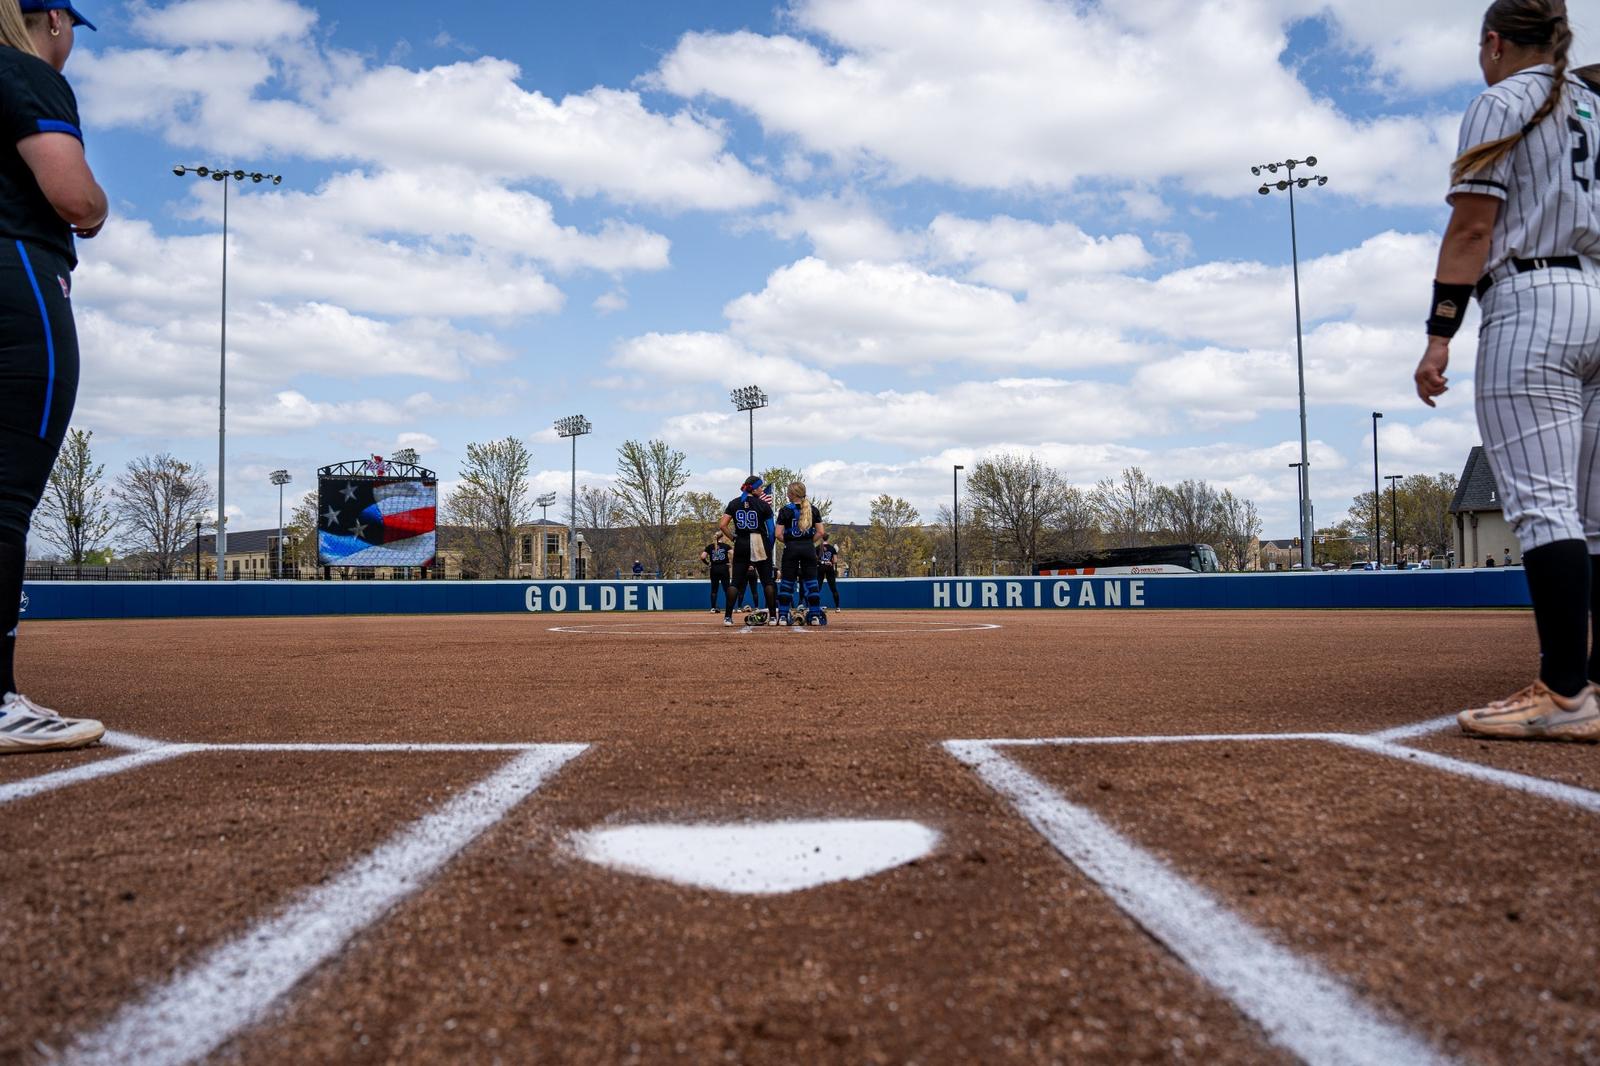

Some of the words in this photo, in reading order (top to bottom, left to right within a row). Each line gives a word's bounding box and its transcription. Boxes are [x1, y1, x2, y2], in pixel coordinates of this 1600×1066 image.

[1567, 114, 1600, 193] 2
[736, 509, 759, 530] 99
[525, 585, 664, 611] GOLDEN
[933, 580, 1145, 607] HURRICANE
